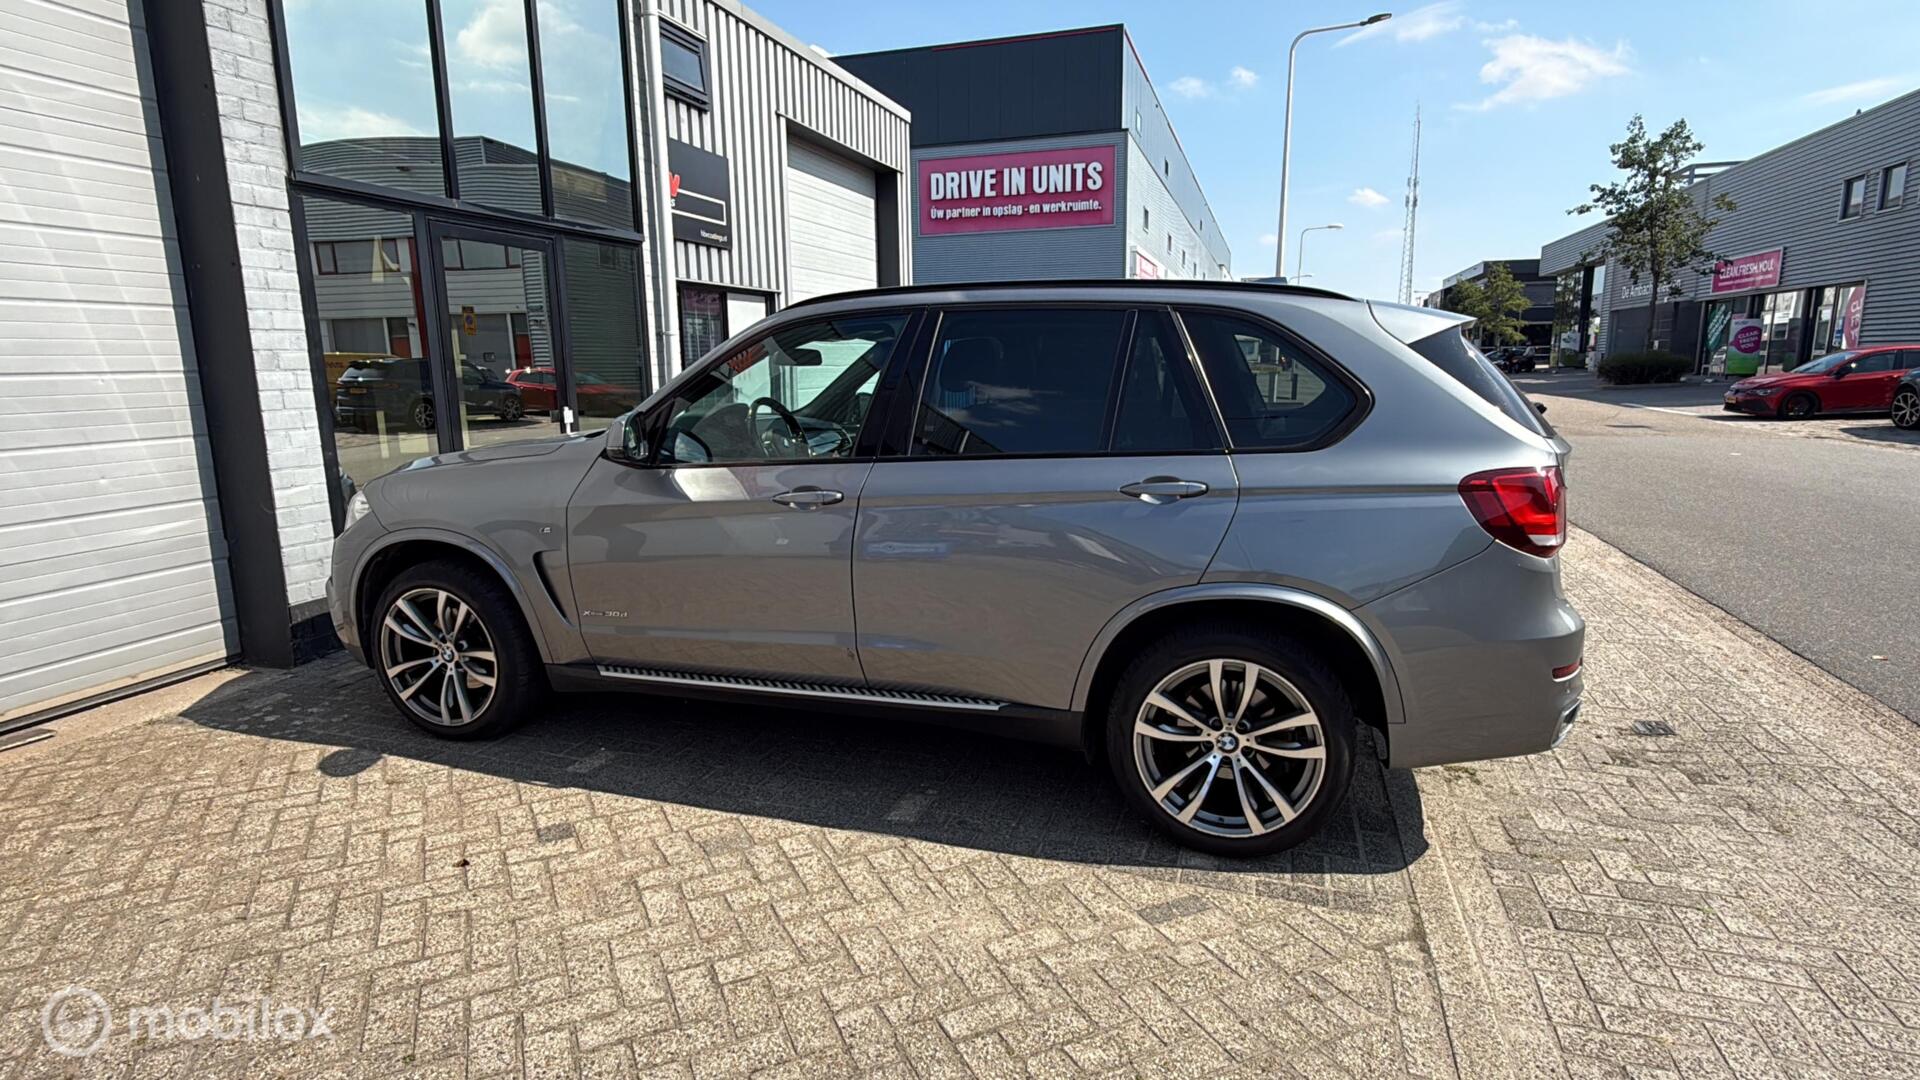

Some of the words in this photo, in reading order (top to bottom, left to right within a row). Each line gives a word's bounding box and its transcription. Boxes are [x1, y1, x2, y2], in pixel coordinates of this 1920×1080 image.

[930, 169, 997, 201] DRIVE
[1003, 166, 1026, 196] IN
[1032, 161, 1104, 194] UNITS
[930, 206, 944, 219] Uw
[945, 205, 981, 221] partner
[982, 205, 991, 217] in
[992, 201, 1023, 218] opslag
[1029, 203, 1040, 213] en
[1042, 199, 1103, 214] werkruimte.
